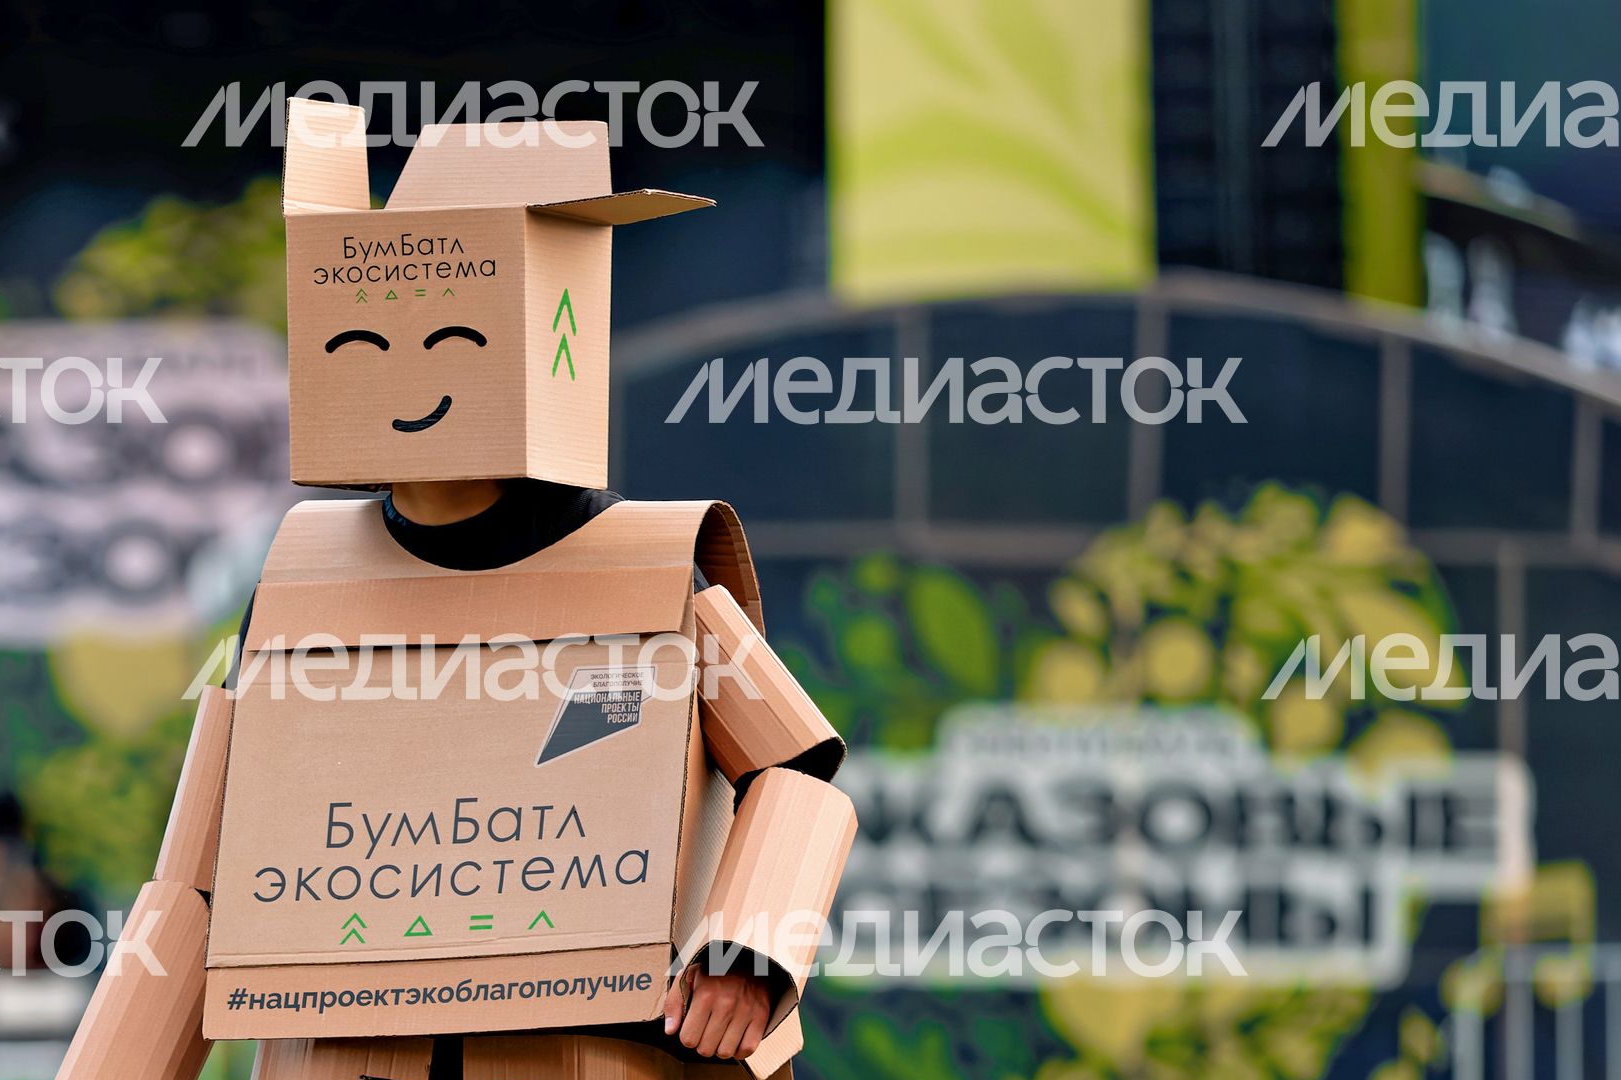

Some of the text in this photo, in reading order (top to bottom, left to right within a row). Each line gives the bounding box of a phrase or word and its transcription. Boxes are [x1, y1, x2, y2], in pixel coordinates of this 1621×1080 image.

[343, 233, 465, 264] БумБатл
[313, 259, 497, 285] экосистема
[573, 691, 641, 705] НАЦИОНАЛЬНЫЕ
[601, 702, 640, 714] ПРОЕКТЫ
[607, 712, 639, 724] РОССИИ
[325, 797, 587, 860] БумБатл
[252, 848, 651, 903] экосистема
[227, 972, 653, 1014] #нацпроектэкоблагополучие
